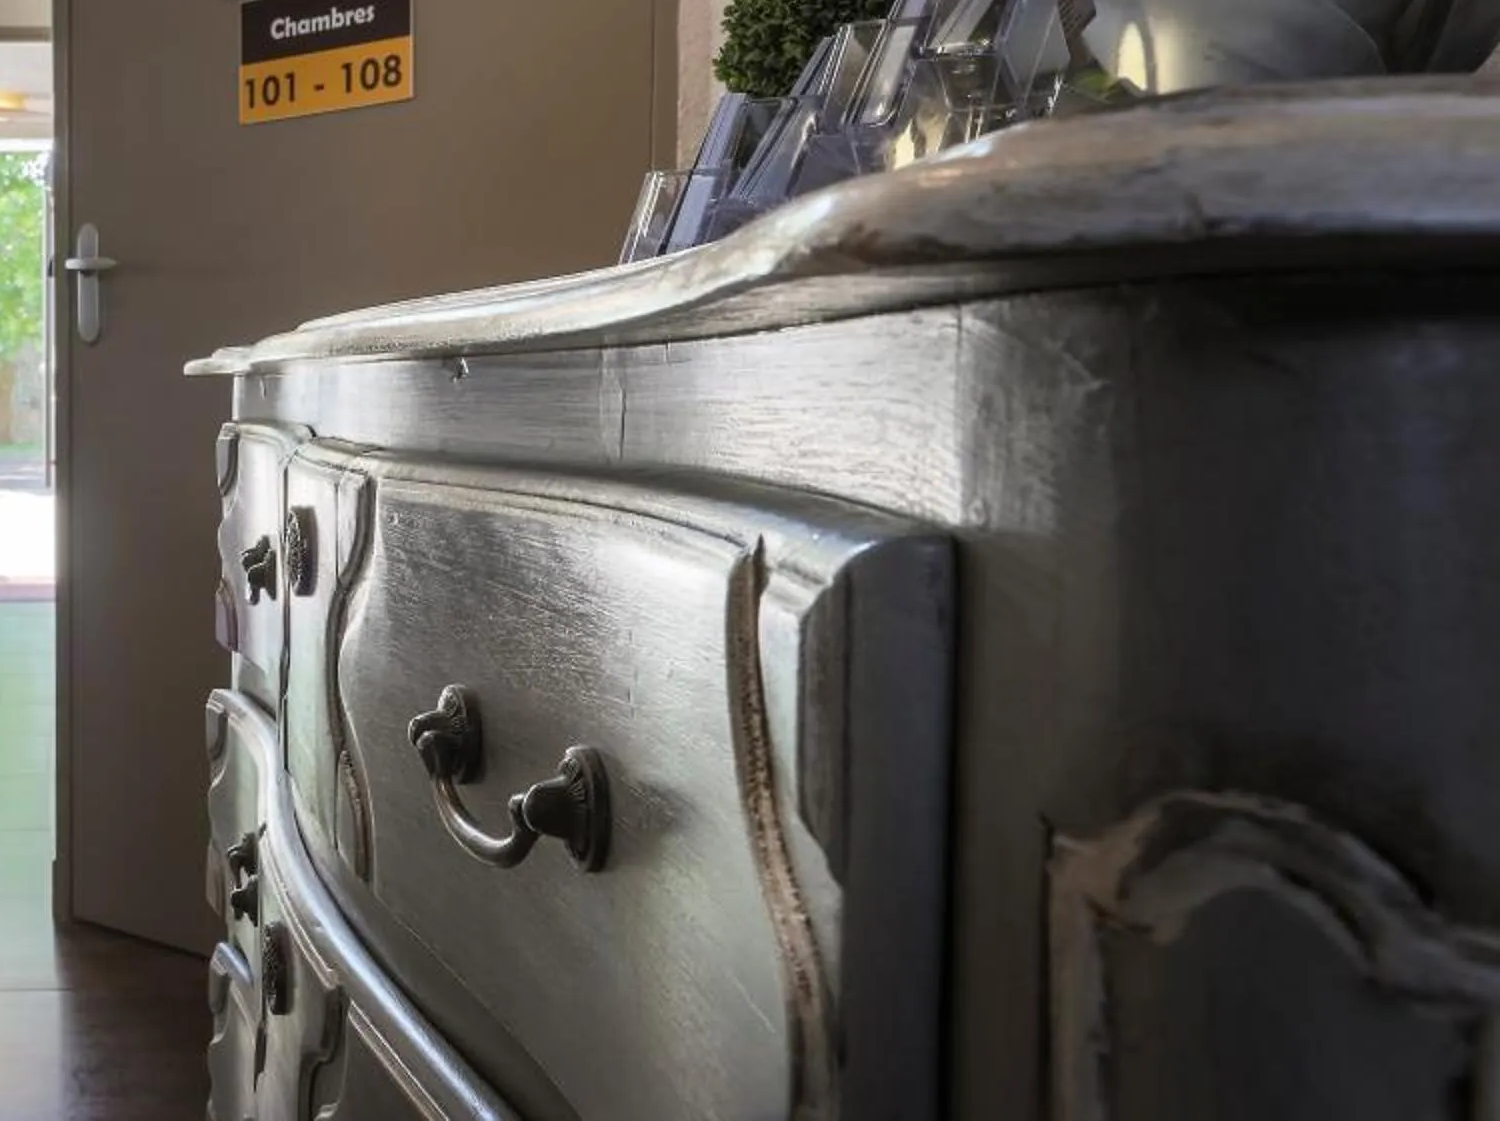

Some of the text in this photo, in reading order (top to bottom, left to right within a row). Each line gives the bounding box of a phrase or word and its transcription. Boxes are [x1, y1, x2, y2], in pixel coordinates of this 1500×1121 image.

[270, 5, 375, 40] Chambres
[244, 72, 296, 109] 101
[341, 54, 402, 93] 108
